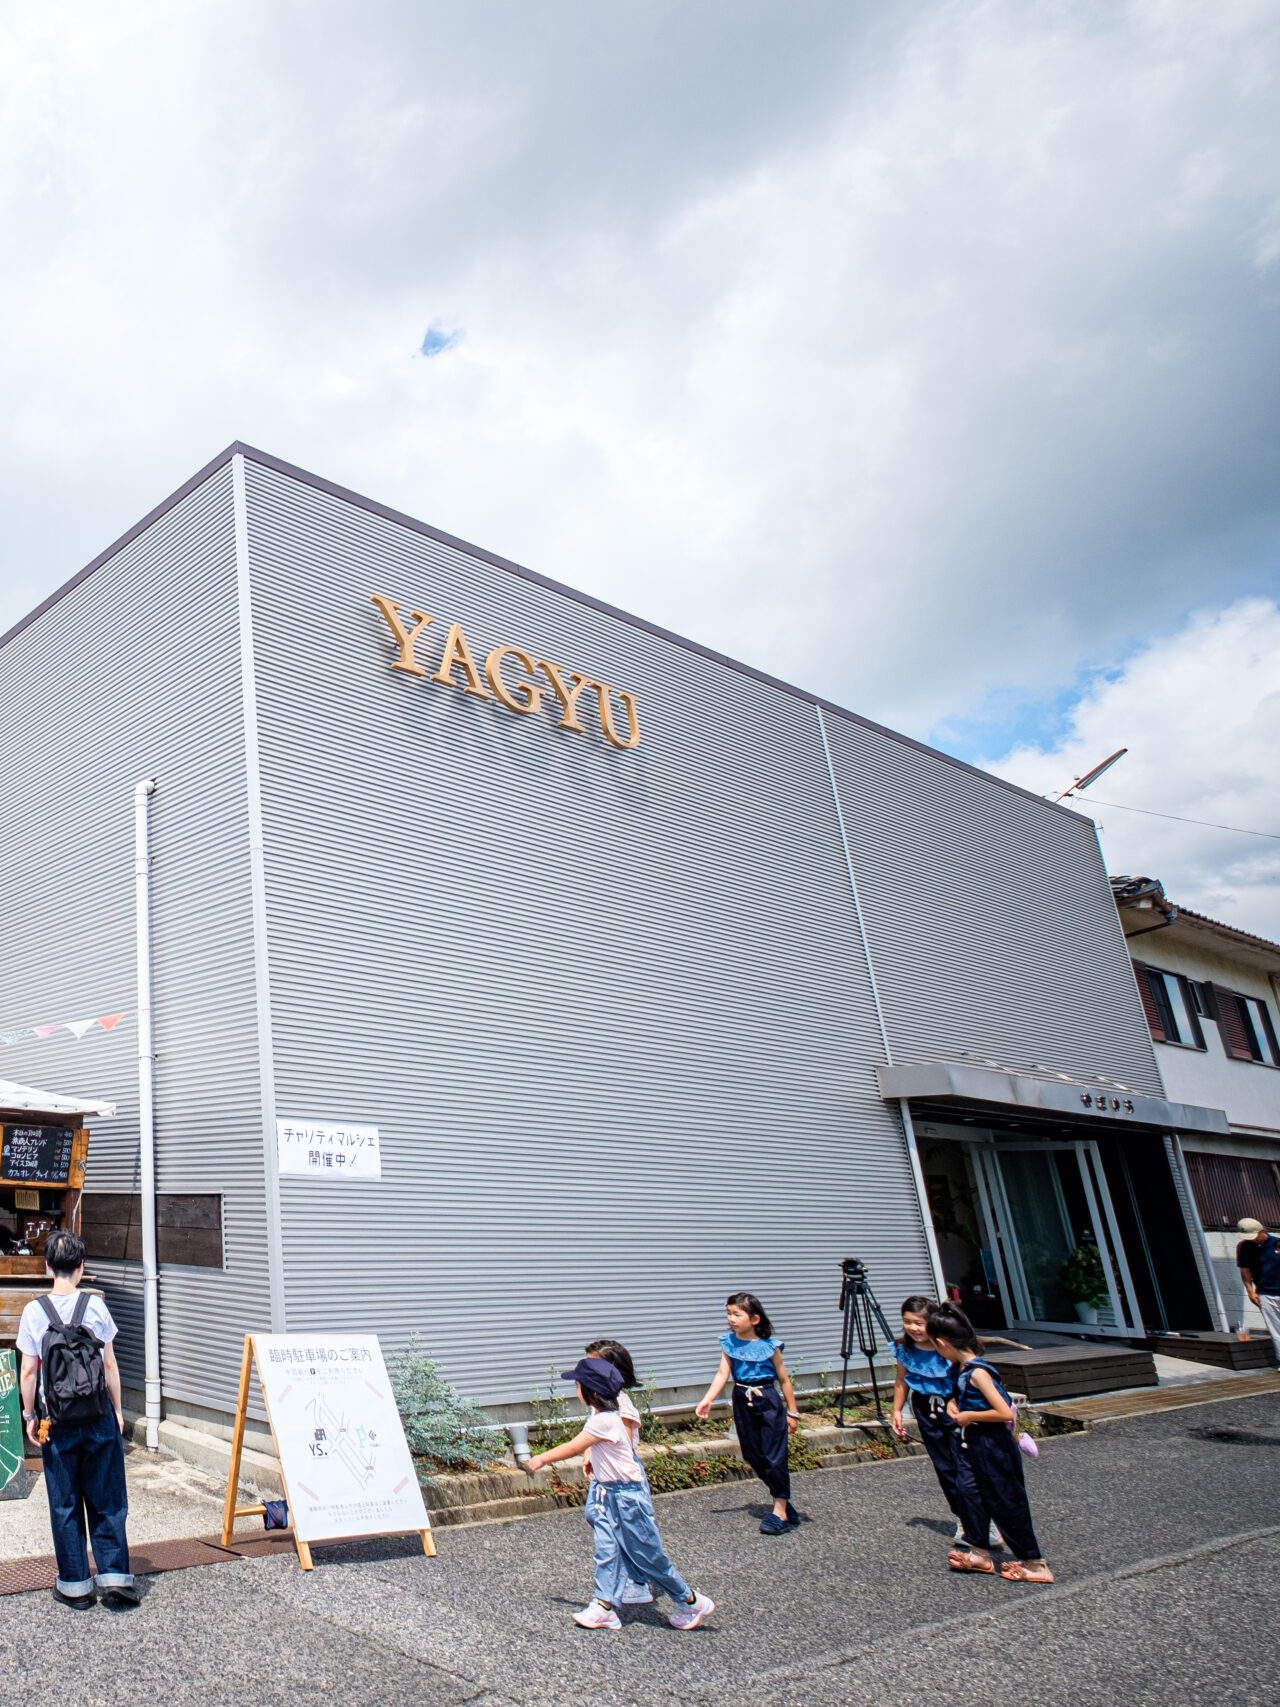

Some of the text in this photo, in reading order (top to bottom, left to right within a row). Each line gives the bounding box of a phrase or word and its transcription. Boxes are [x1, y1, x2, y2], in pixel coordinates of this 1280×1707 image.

[371, 594, 641, 750] YAGYU
[283, 1128, 375, 1147] チャリティマルシェ
[269, 1347, 372, 1363] 臨時駐車場のご案内
